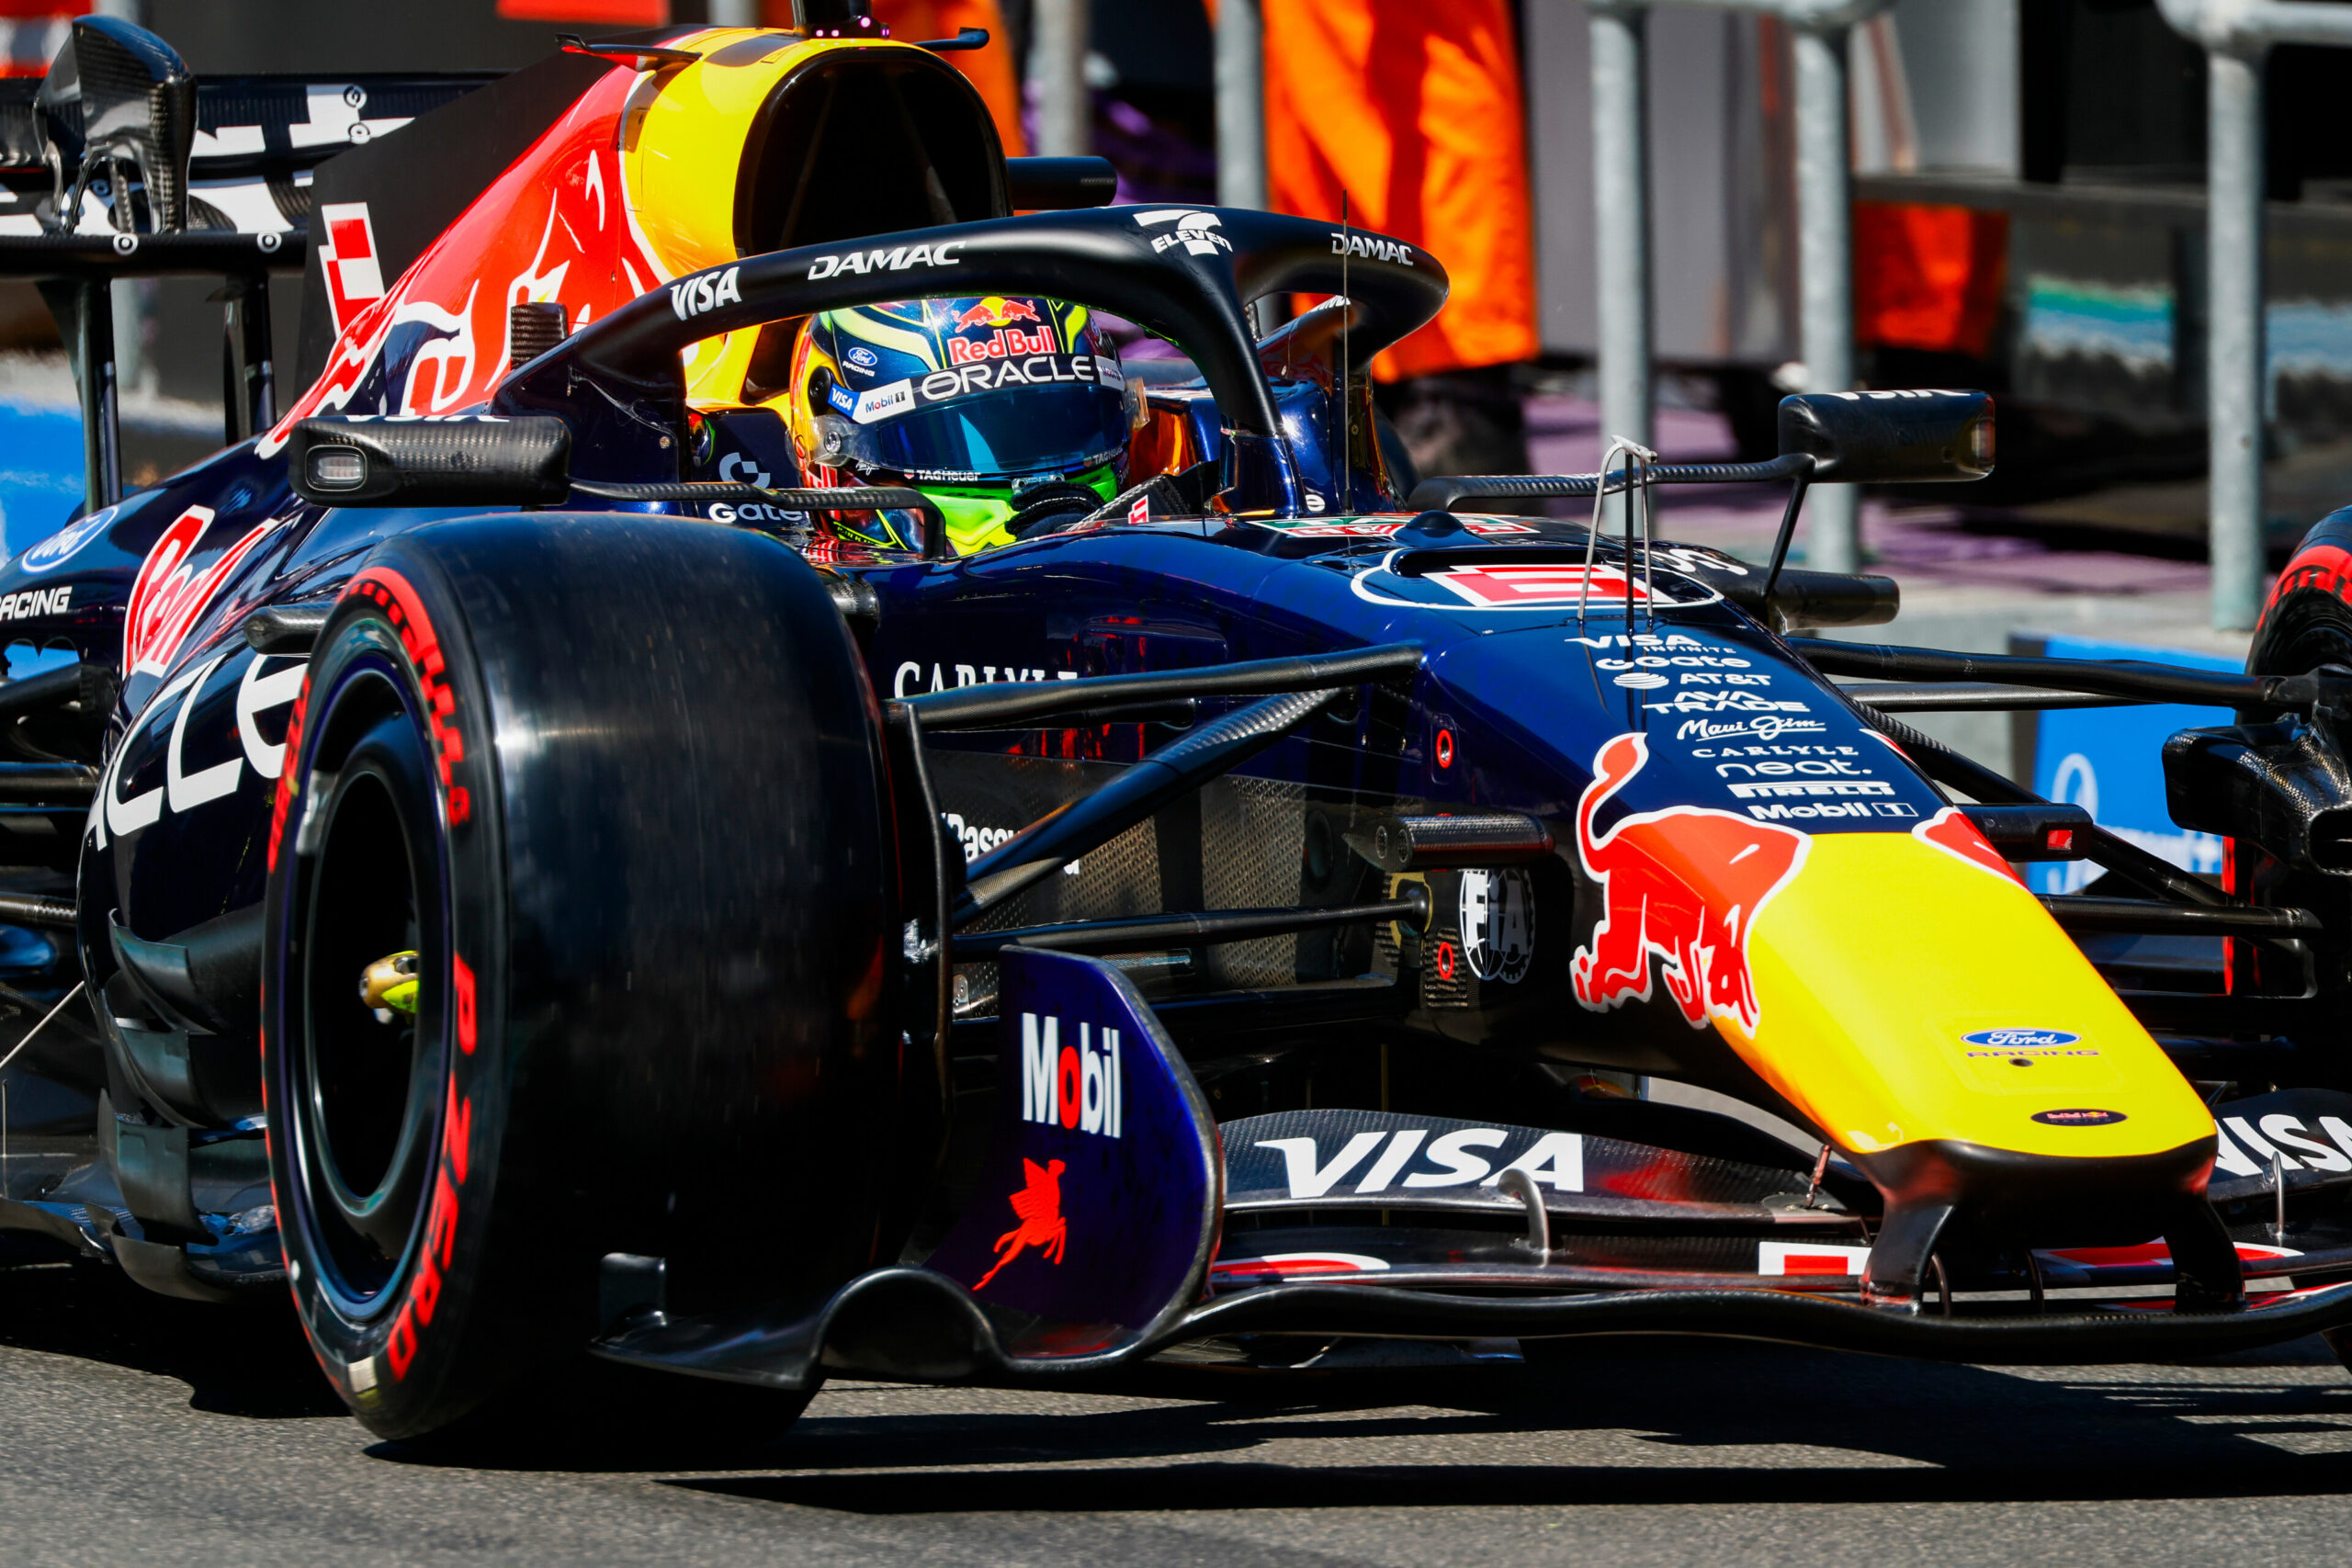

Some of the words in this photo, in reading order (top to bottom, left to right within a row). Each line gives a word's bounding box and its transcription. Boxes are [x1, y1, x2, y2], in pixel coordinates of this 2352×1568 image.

[1330, 232, 1414, 266] DAMAC
[808, 241, 966, 280] DAMAC
[670, 266, 742, 321] VISA
[947, 329, 1008, 366] Red
[1005, 325, 1057, 356] Bull
[850, 349, 874, 366] Ford
[842, 361, 875, 378] RACING
[922, 355, 1094, 400] ORACLE
[831, 387, 854, 411] VISA
[865, 395, 894, 413] Mobil
[708, 502, 803, 524] Gate
[0, 586, 73, 622] ACING
[1565, 634, 1702, 649] VISA
[1643, 646, 1736, 654] INFINITE
[1680, 673, 1771, 685] AT&T
[1674, 691, 1765, 702] AVA
[1642, 701, 1811, 714] TRADE
[1677, 719, 1747, 740] Maui
[1750, 716, 1826, 740] Jim
[1692, 746, 1859, 758] CARLYLE
[1715, 760, 1872, 777] neat.
[1727, 781, 1895, 798] PIRELLI
[1747, 803, 1871, 819] Mobil
[454, 951, 476, 1056] P
[1987, 1030, 2058, 1045] Ford
[1022, 1012, 1121, 1138] Mobil
[1254, 1129, 1584, 1198] VISA
[388, 1070, 471, 1382] ZERO
